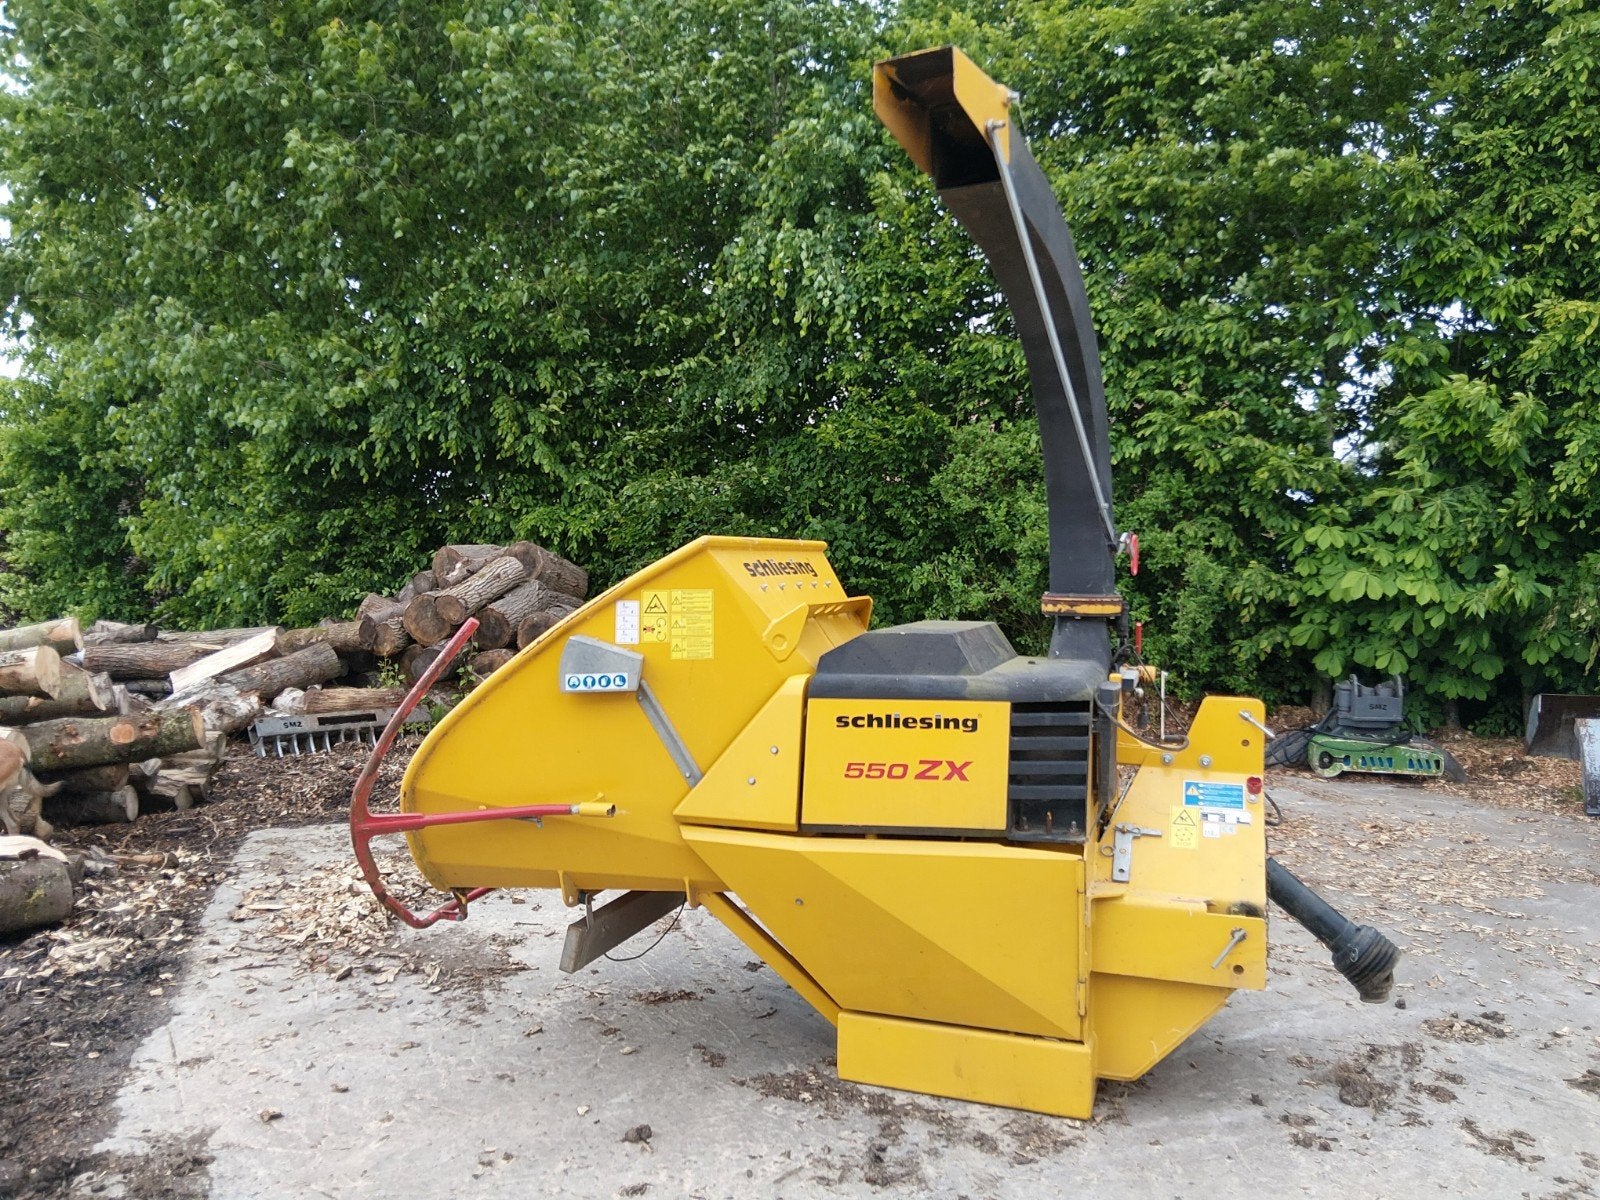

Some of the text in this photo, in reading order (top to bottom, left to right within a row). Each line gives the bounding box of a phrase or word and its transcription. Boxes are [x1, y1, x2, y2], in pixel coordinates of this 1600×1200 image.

[743, 557, 818, 577] schliesing
[836, 713, 978, 733] schliesing
[844, 759, 974, 782] 550 ZX
